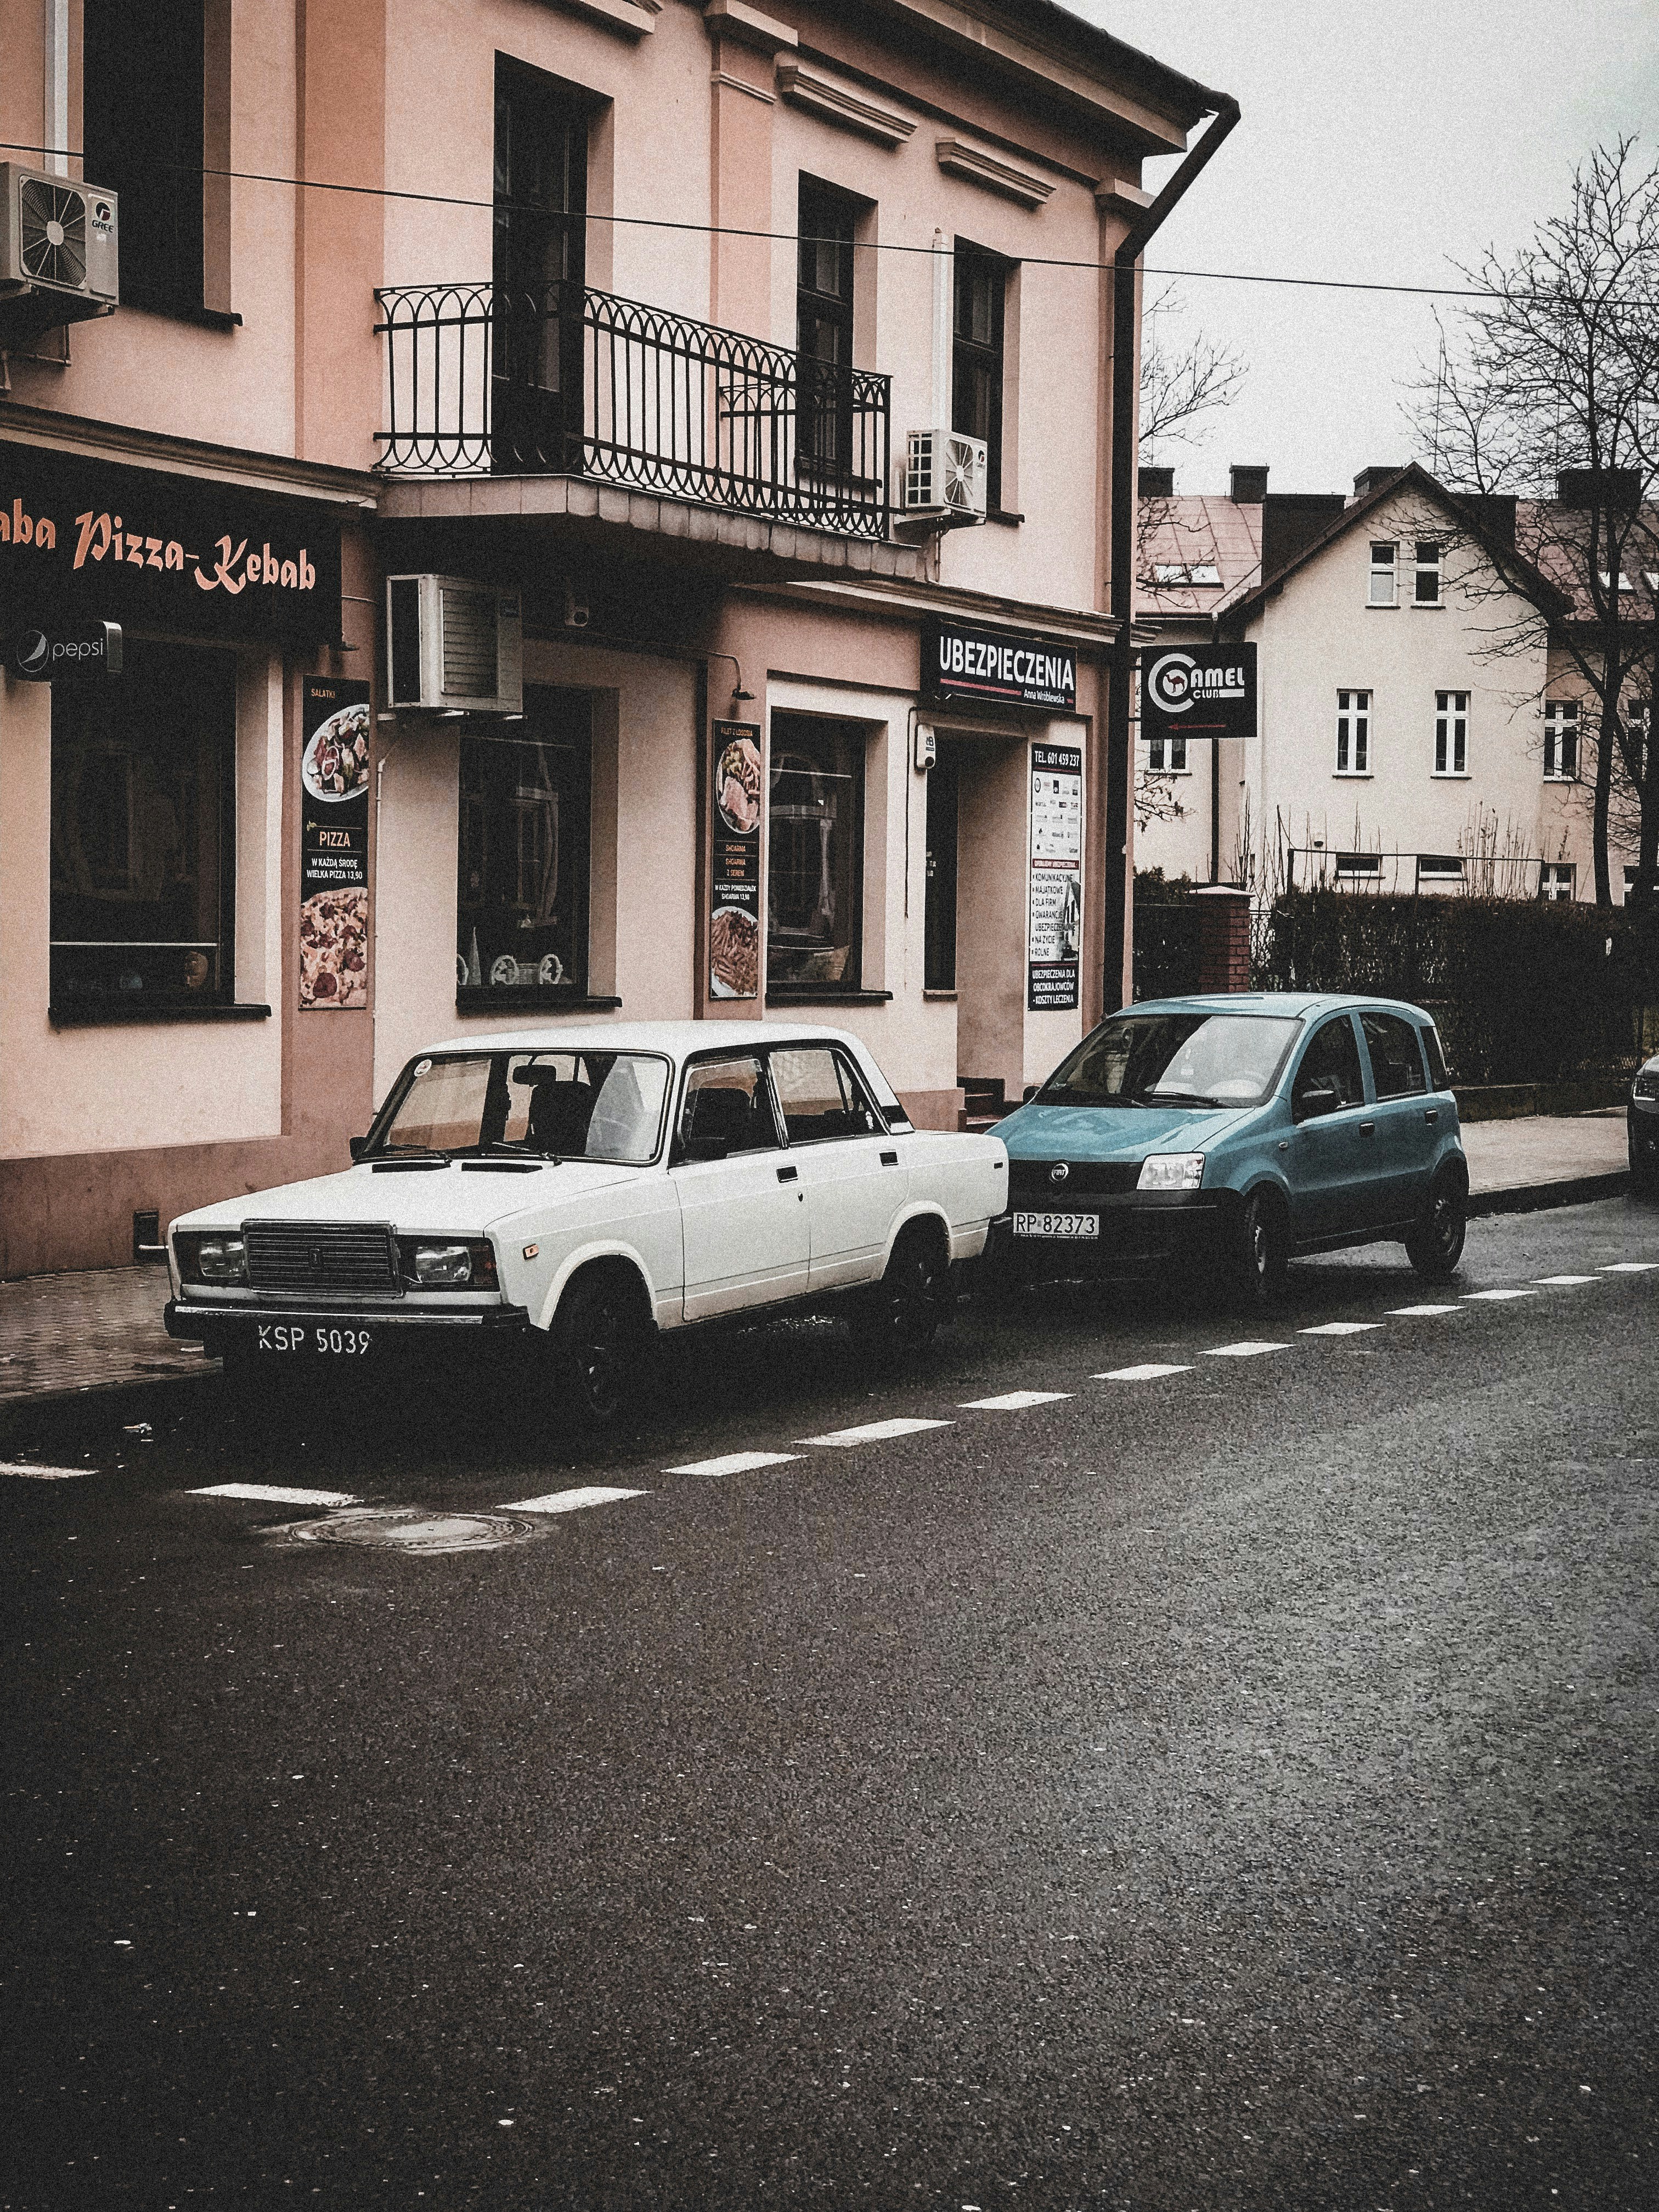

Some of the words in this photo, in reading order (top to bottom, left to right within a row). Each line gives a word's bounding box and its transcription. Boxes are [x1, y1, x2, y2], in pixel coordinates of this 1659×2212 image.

[92, 220, 114, 233] GREE
[53, 637, 104, 661] pepsi
[940, 636, 1074, 691] UBEZPIECZENIA
[1148, 653, 1245, 713] CAMEL
[1024, 689, 1036, 700] Anna
[1193, 689, 1220, 699] CLUB
[1034, 750, 1047, 763] TEL.
[1047, 752, 1058, 764] 601
[1058, 753, 1069, 766] 459
[1069, 754, 1080, 767] 237
[319, 831, 351, 847] PIZZA
[311, 857, 318, 866] W
[318, 856, 338, 869] KAŻDĄ
[338, 857, 358, 870] ŚRODĘ
[307, 870, 329, 878] WIELKA
[329, 870, 346, 879] PIZZA
[347, 871, 363, 881] 13,90
[1066, 969, 1075, 978] DLA
[1016, 1214, 1037, 1232] RP
[1043, 1215, 1095, 1234] 82373
[258, 1325, 304, 1351] KSP
[317, 1328, 370, 1355] 5039
